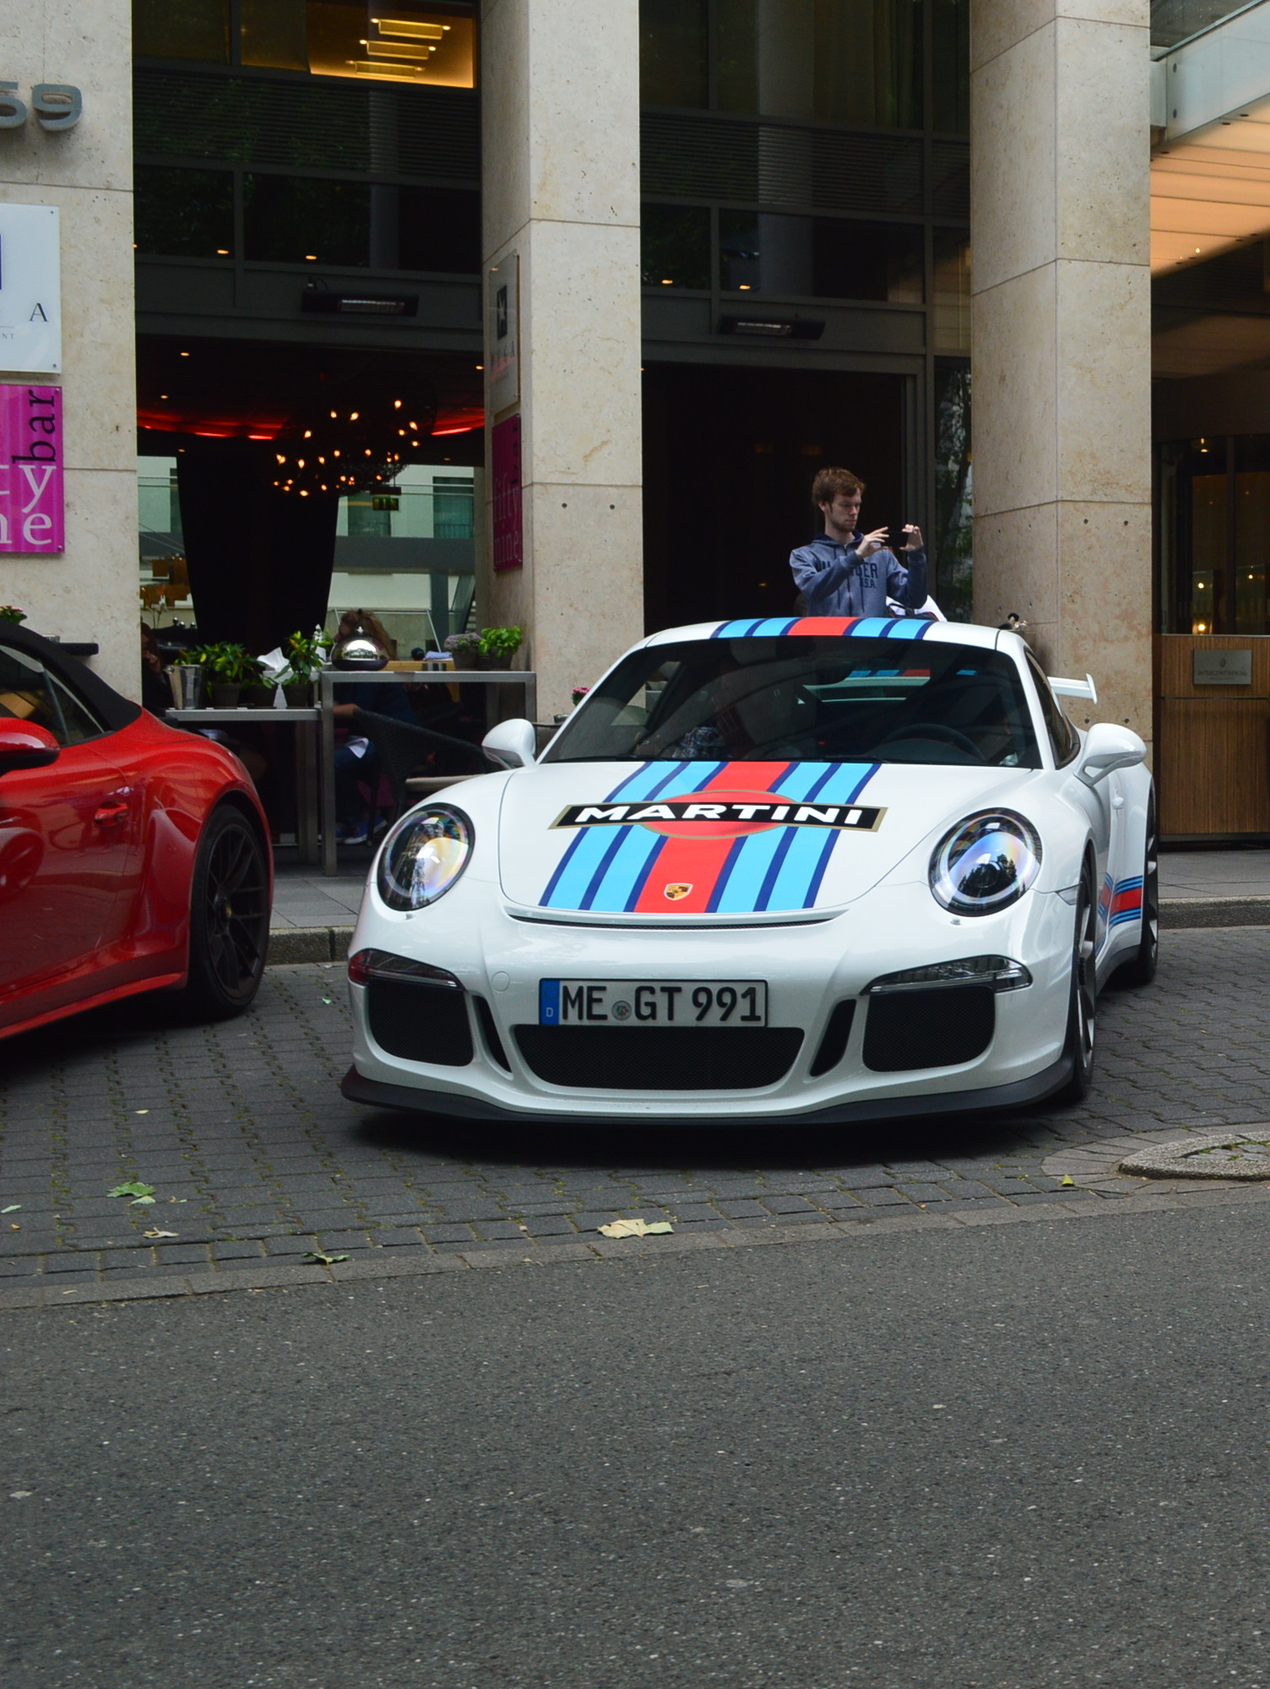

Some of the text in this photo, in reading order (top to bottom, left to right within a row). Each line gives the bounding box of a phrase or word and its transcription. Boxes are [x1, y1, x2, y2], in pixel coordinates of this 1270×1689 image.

[11, 389, 56, 463] bar
[574, 803, 863, 825] MARTINI
[546, 985, 762, 1021] D ME GT 991
